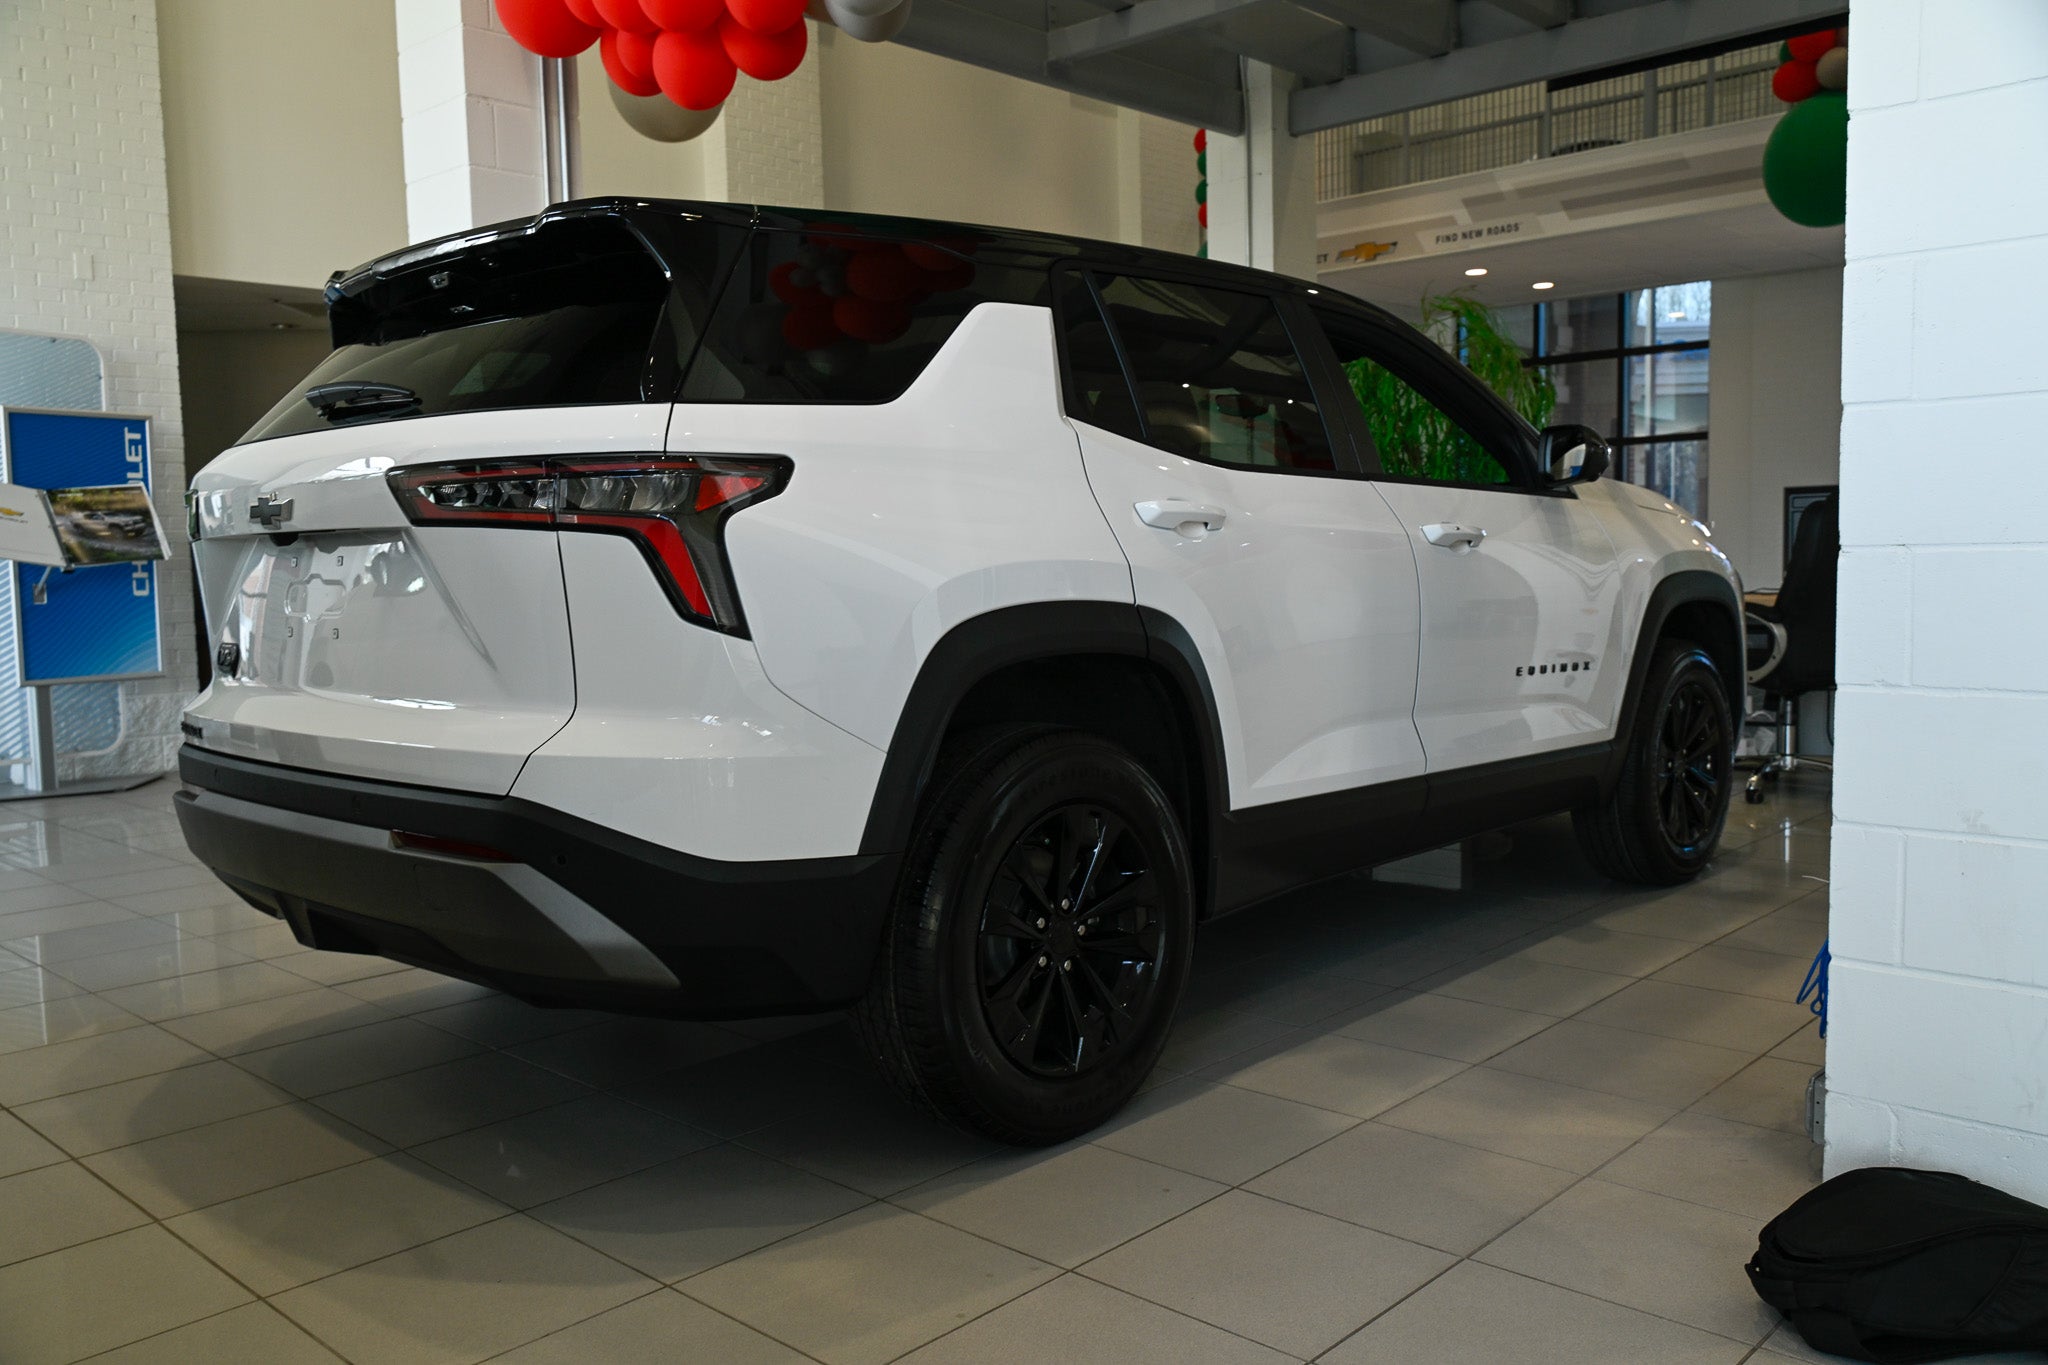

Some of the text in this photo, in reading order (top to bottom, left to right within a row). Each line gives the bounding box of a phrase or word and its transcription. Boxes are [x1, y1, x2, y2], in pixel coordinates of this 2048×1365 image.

[1435, 222, 1519, 244] FIND NEW ROADS
[124, 426, 149, 596] CHLET
[1515, 661, 1590, 677] EQUINOX
